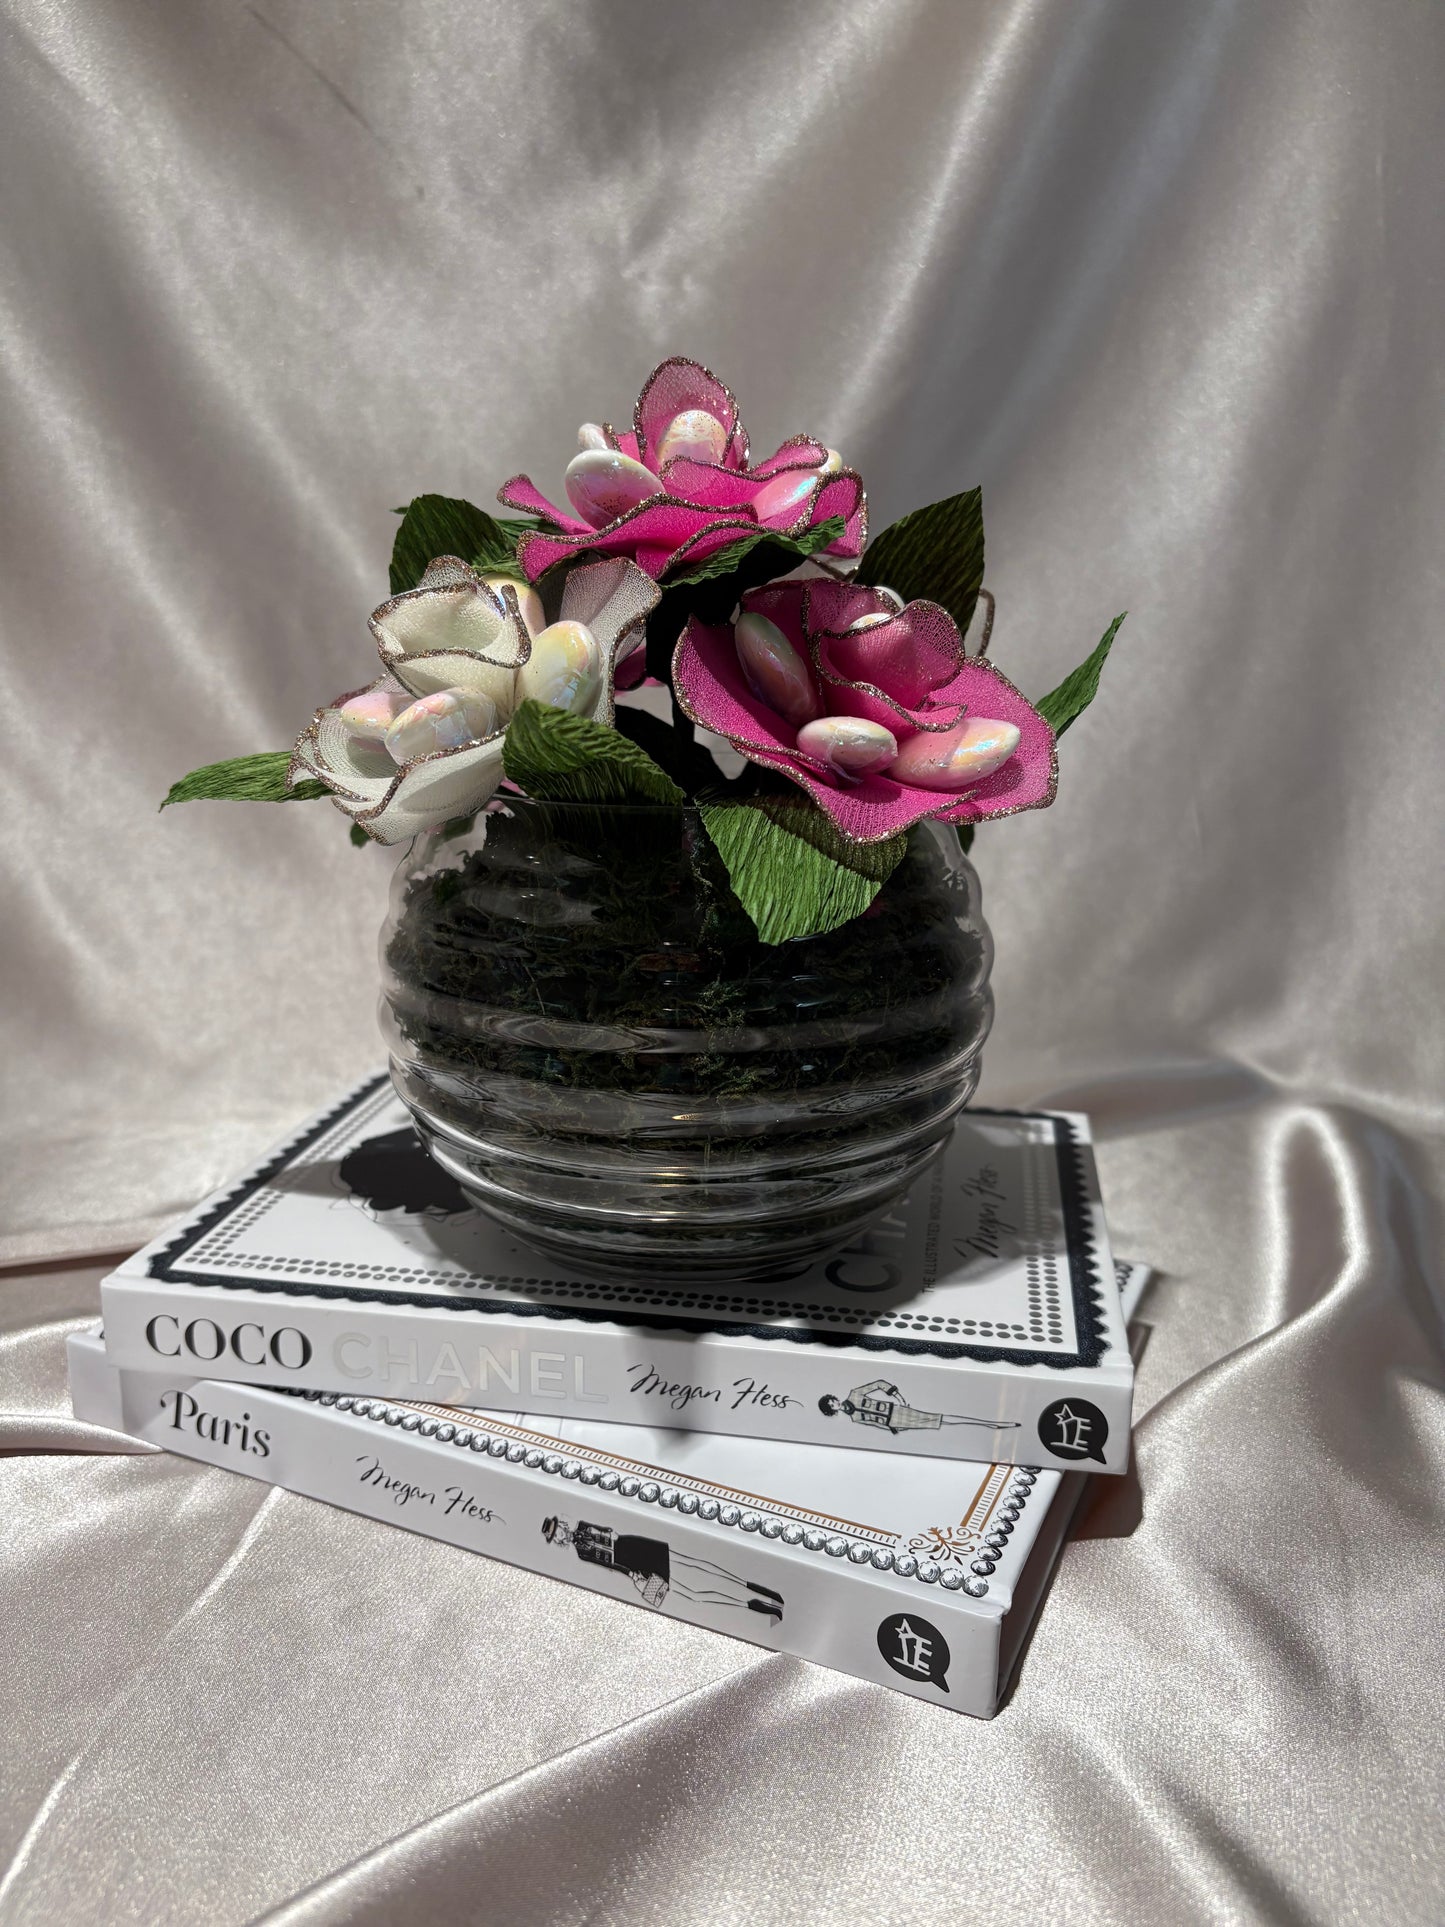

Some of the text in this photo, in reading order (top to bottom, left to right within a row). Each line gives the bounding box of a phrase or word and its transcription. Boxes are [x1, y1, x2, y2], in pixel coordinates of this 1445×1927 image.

[924, 1222, 940, 1276] ILLUSTRATED
[921, 1277, 936, 1294] THE
[145, 1313, 804, 1410] COCO CHANEL Megan Hess
[159, 1389, 272, 1459] Paris
[356, 1455, 507, 1526] Megan Hess
